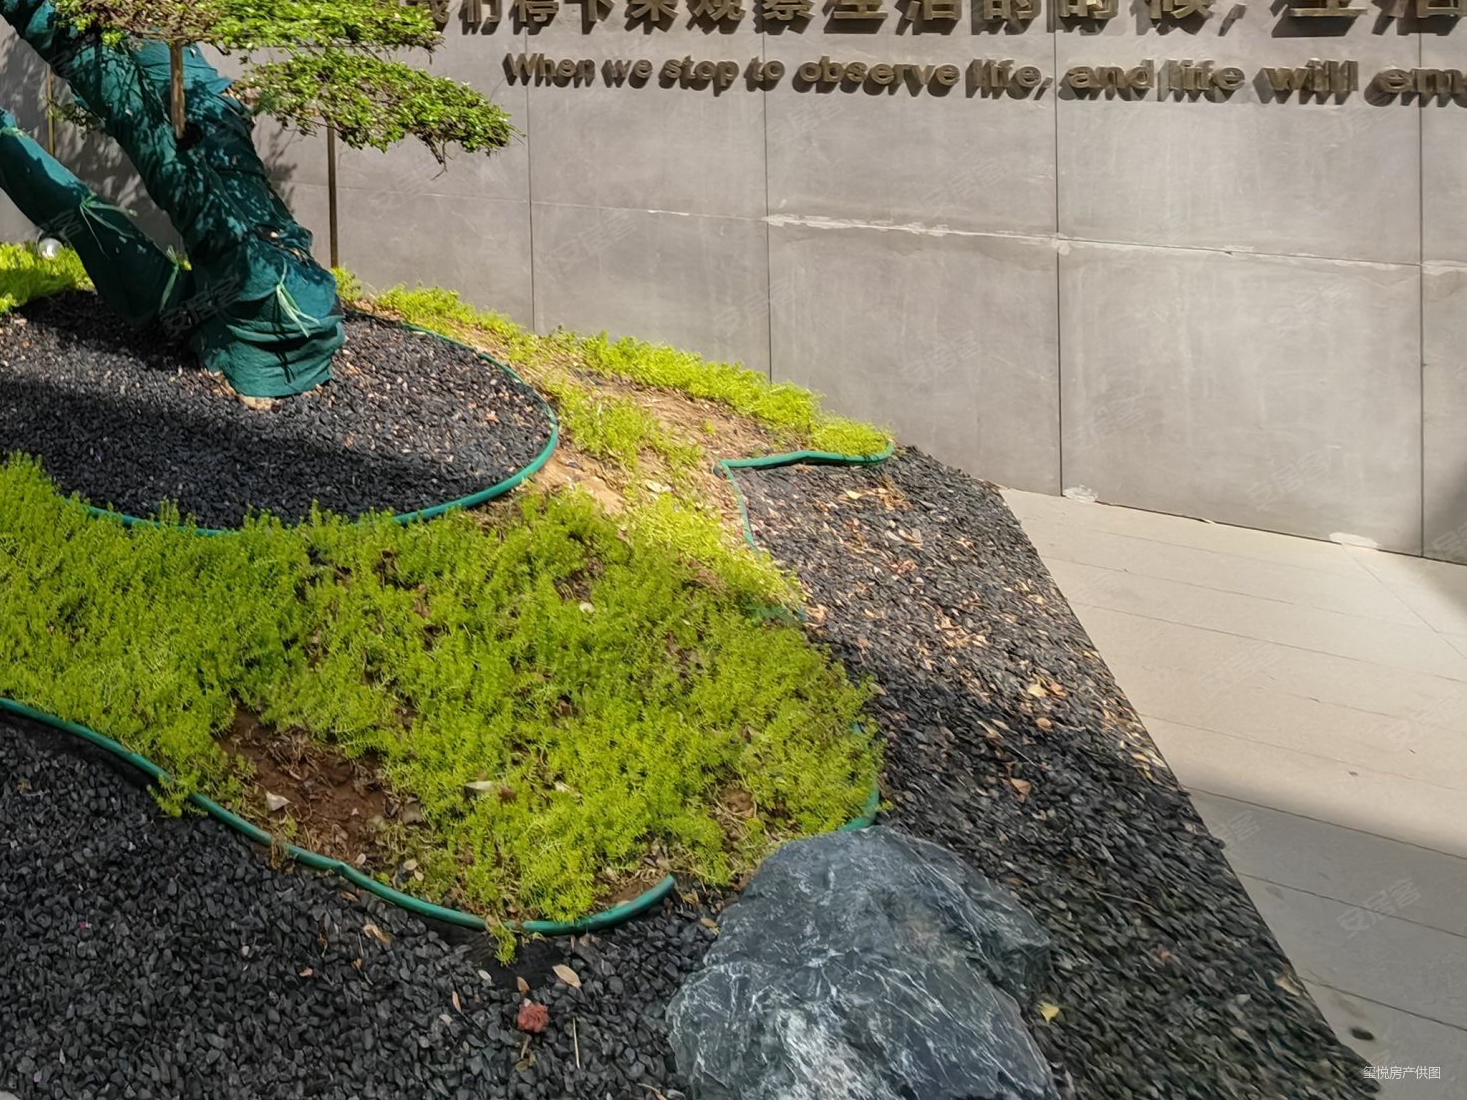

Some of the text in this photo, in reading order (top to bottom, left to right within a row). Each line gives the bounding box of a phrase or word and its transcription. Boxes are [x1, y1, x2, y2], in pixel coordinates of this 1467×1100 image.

[503, 52, 1467, 102] When we stop to observe life, and life will em
